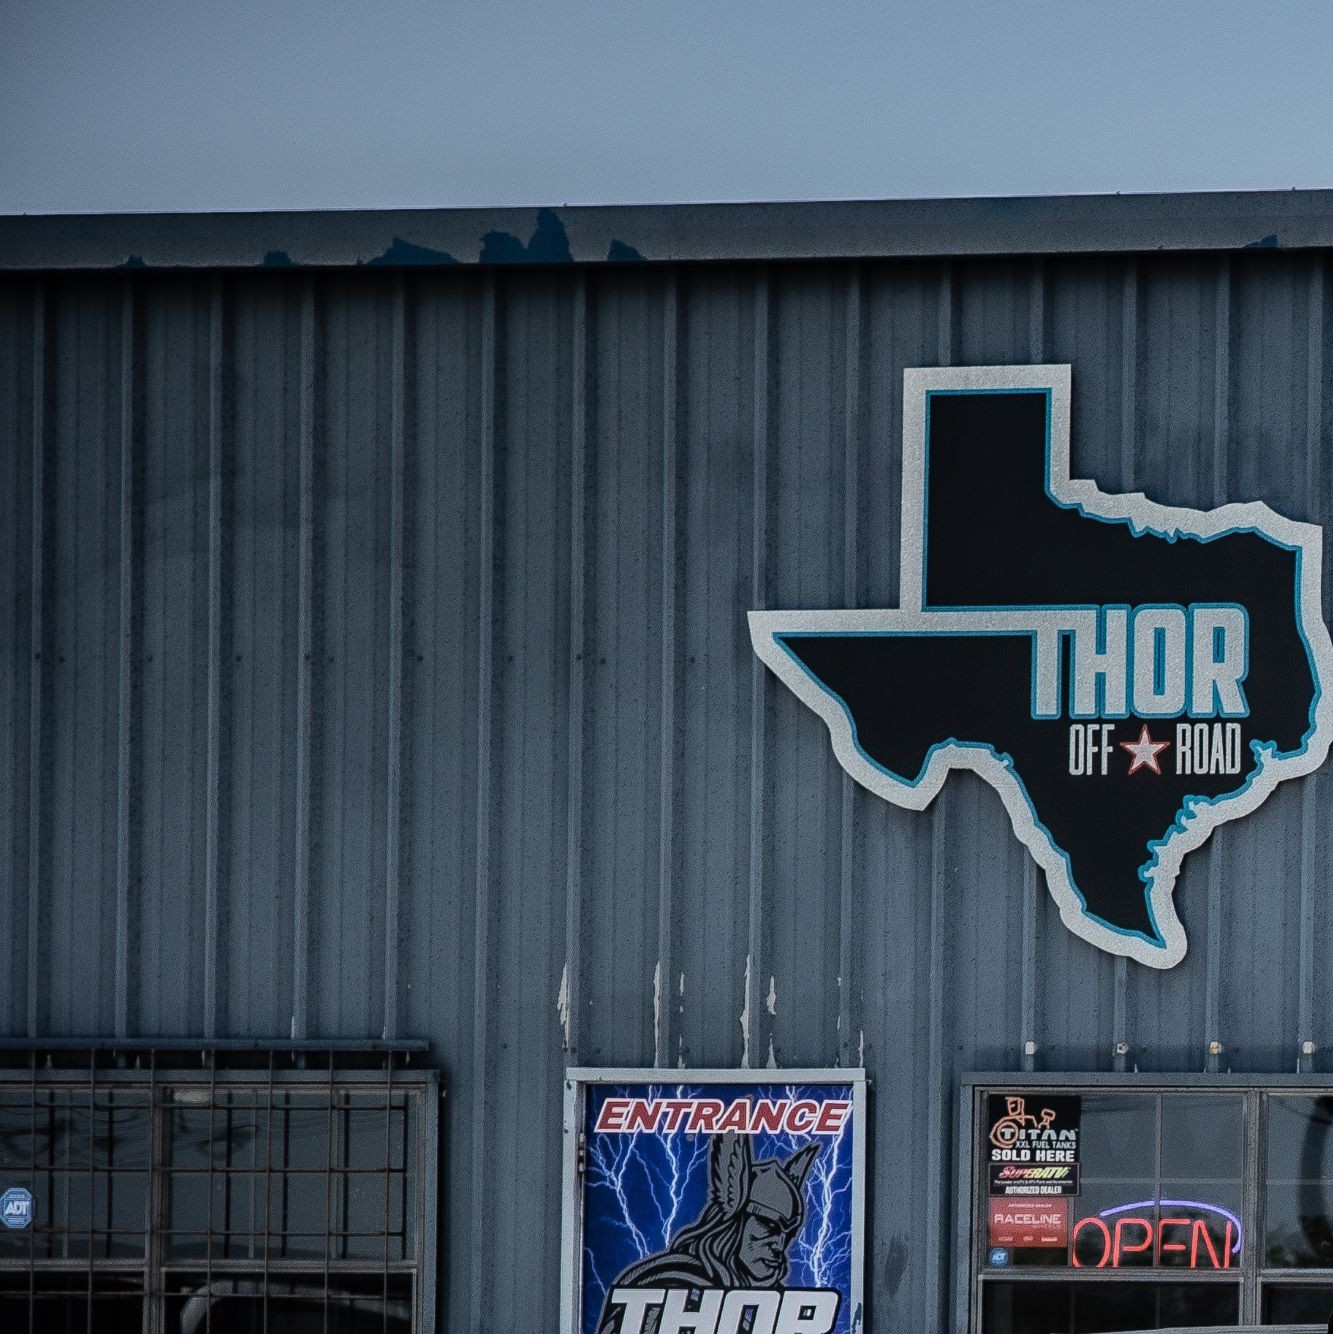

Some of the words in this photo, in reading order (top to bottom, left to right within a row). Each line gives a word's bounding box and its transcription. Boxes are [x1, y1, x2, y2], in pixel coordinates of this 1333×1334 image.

[1030, 602, 1250, 719] THOR
[1069, 724, 1115, 775] OFF
[1176, 723, 1241, 774] ROAD
[593, 1097, 853, 1134] ENTRANCE
[1000, 1127, 1077, 1140] TITAN
[1032, 1141, 1050, 1149] FUEL
[1053, 1141, 1076, 1149] TANKS
[991, 1149, 1031, 1161] SOLD
[1036, 1149, 1075, 1162] HERE
[994, 1213, 1062, 1225] RACELINE
[1072, 1217, 1233, 1268] OPEN
